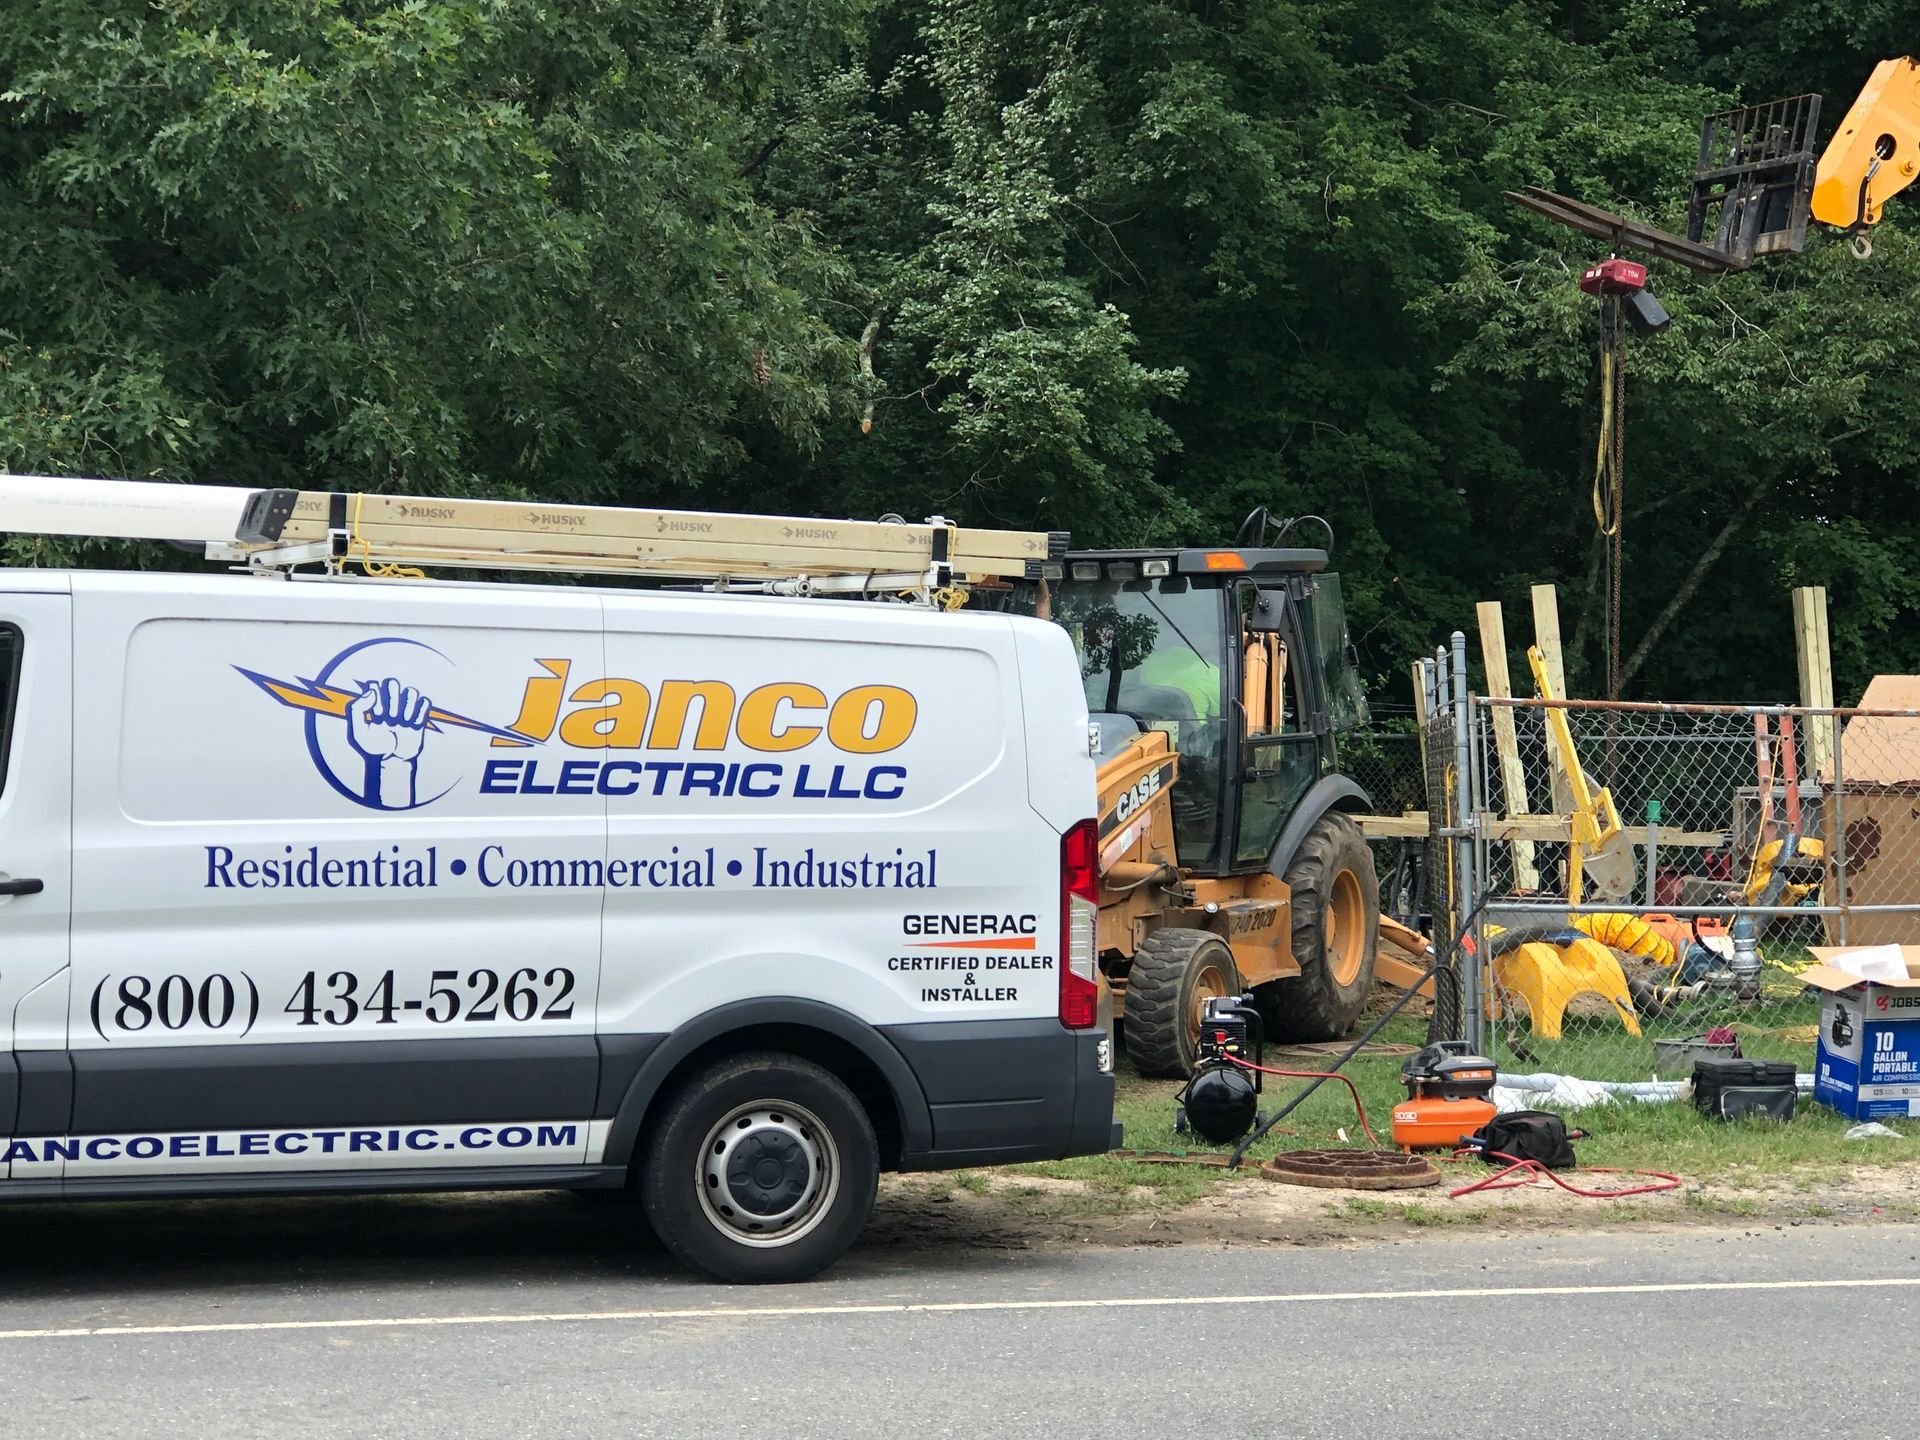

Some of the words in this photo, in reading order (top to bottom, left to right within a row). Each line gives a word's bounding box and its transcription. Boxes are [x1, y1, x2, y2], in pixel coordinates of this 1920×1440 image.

[296, 500, 323, 512] SKY
[541, 513, 586, 526] HUSKY
[670, 520, 712, 533] HUSKY
[795, 528, 838, 540] HUSKY
[480, 759, 782, 797] ELECTRIC
[793, 764, 907, 800] LLC
[1116, 764, 1160, 822] CASE
[205, 845, 437, 890] Residential
[477, 846, 715, 889] Commercial
[753, 847, 938, 889] Industrial
[903, 914, 1037, 935] GENERAC
[887, 956, 980, 971] CERTIFIED
[985, 956, 1054, 970] DEALER
[963, 971, 976, 986] &
[921, 987, 1018, 1002] INSTALLER
[90, 972, 260, 1042] (800)
[284, 967, 575, 1026] 434-5262
[1875, 1031, 1894, 1052] 10
[1873, 1051, 1908, 1063] GALLON
[1821, 1062, 1830, 1076] 10
[1872, 1061, 1918, 1074] PORTABLE
[1872, 1074, 1883, 1082] AIR
[0, 1124, 577, 1162] ANCOELECTRIC.COM
